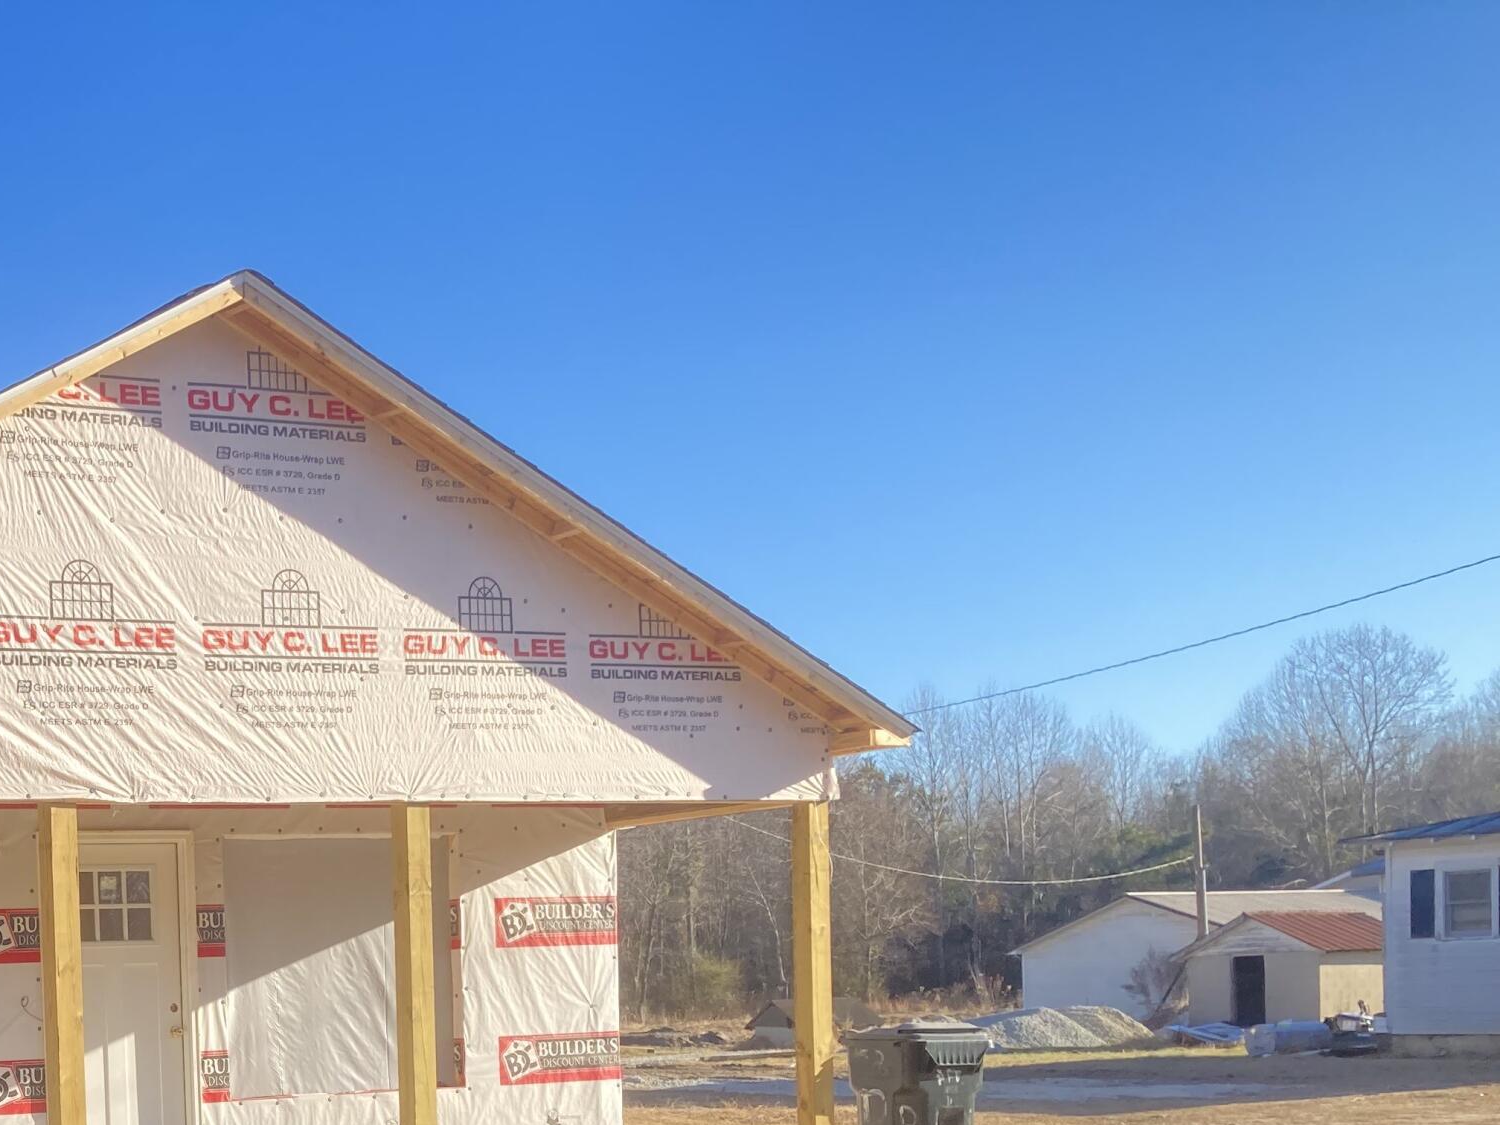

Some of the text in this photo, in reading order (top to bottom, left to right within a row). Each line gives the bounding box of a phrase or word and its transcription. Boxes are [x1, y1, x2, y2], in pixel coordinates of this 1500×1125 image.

[100, 382, 160, 406] LEE
[187, 389, 364, 423] GUY C. LEE
[61, 410, 162, 429] MATERIALS
[190, 420, 367, 443] BUILDING MATERIALS
[326, 455, 345, 465] LWE
[73, 624, 104, 647] C.
[113, 626, 176, 649] LEE
[202, 629, 378, 654] GUY C. LEE
[404, 635, 566, 658] GUY C. LEE
[589, 639, 734, 662] GUY C. LE
[77, 656, 177, 670] MATERIALS
[205, 660, 380, 675] BUILDING MATERIALS
[405, 665, 568, 678] BUILDING MATERIALS
[591, 668, 742, 682] BUILDING MATERIALS
[535, 902, 616, 920] BUILDER'S
[537, 1037, 619, 1057] BUILDER'S
[543, 1054, 619, 1068] DISCOUNT CENTER
